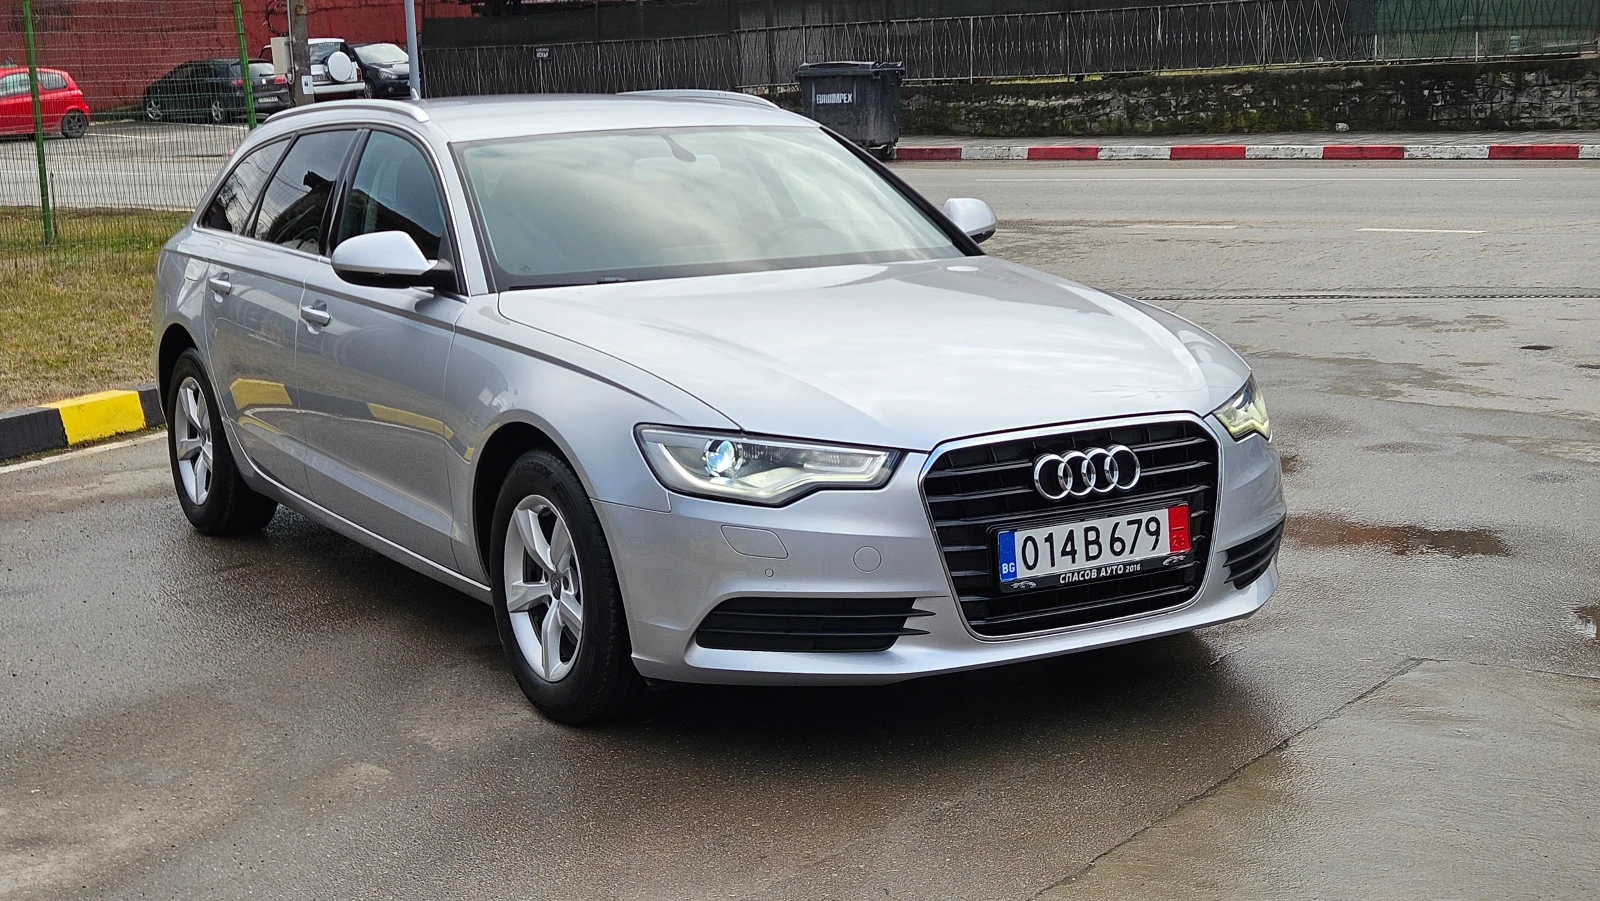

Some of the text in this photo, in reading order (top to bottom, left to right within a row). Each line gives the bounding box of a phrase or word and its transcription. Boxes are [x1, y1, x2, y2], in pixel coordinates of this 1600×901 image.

[816, 93, 853, 104] EUROIMPEX
[1002, 562, 1016, 574] BG
[1059, 563, 1141, 584] СПАСОВ АУТО 2016
